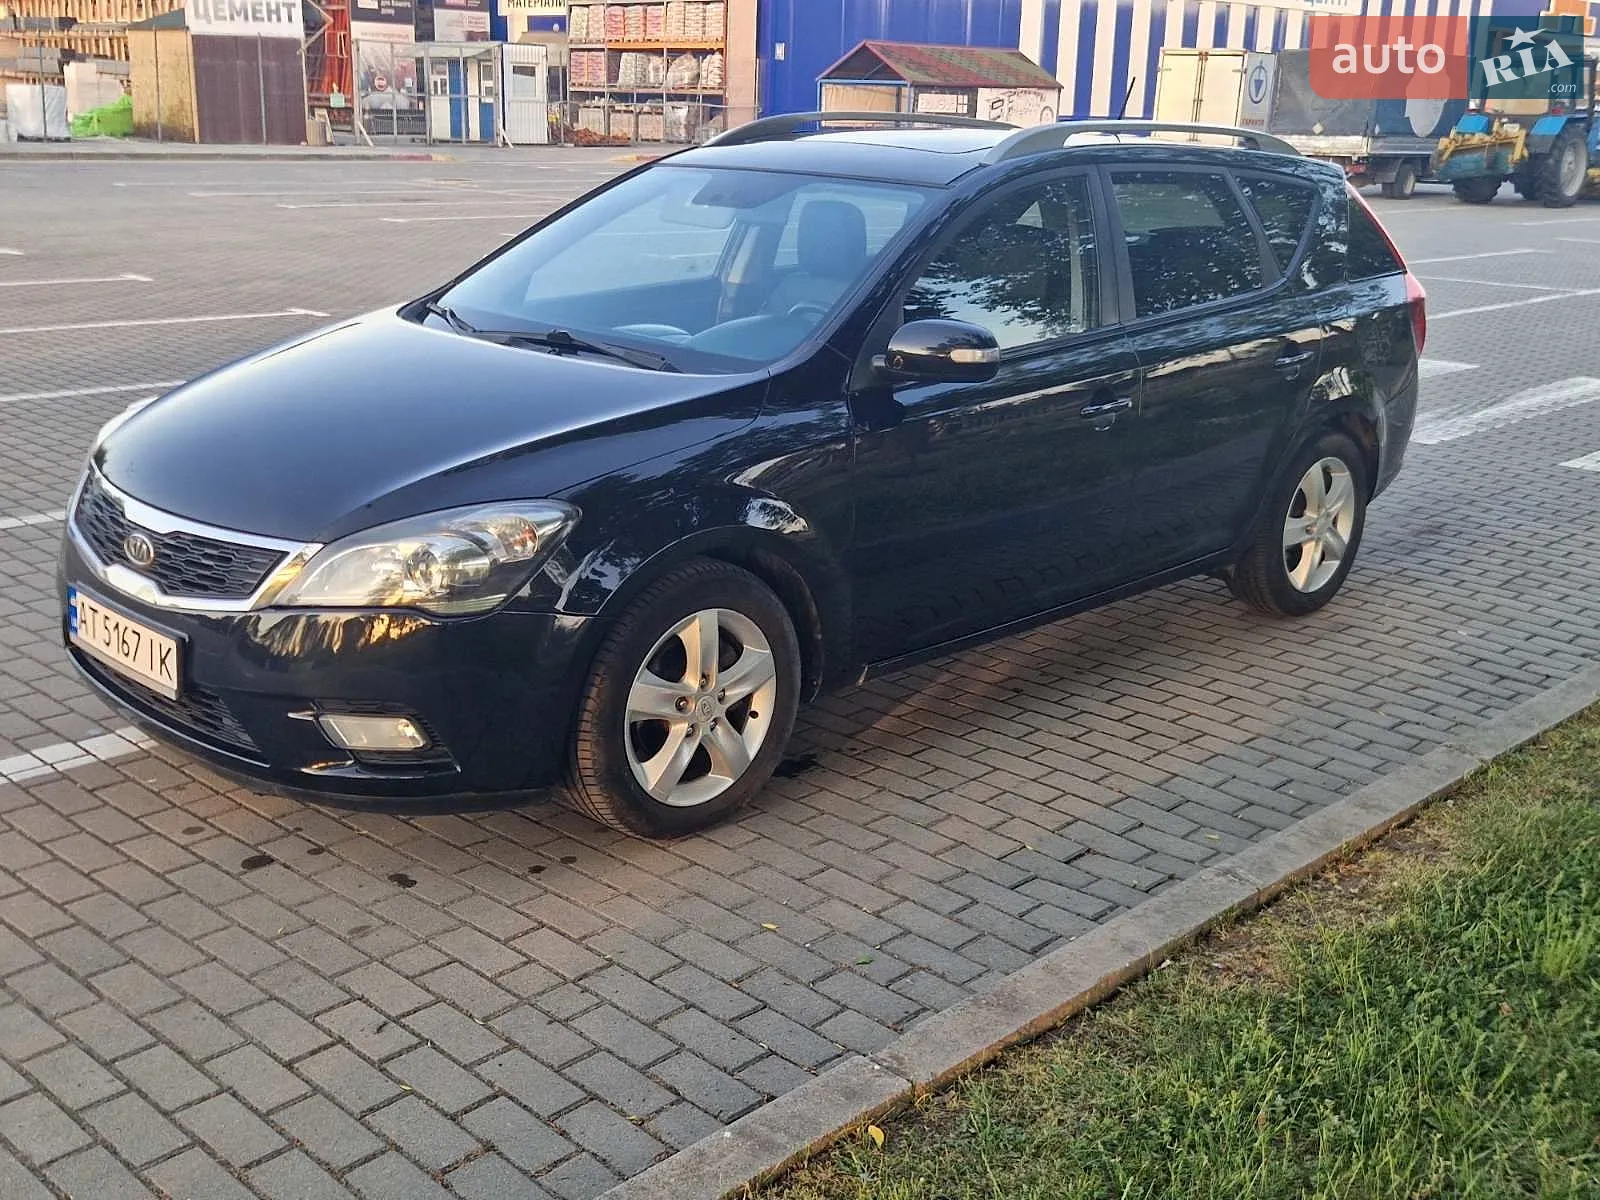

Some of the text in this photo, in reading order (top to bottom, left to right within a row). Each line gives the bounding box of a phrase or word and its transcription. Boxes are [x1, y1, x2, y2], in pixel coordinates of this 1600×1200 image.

[193, 0, 296, 24] ЦЕМЕНТ
[79, 601, 172, 681] AT 5167 IK
